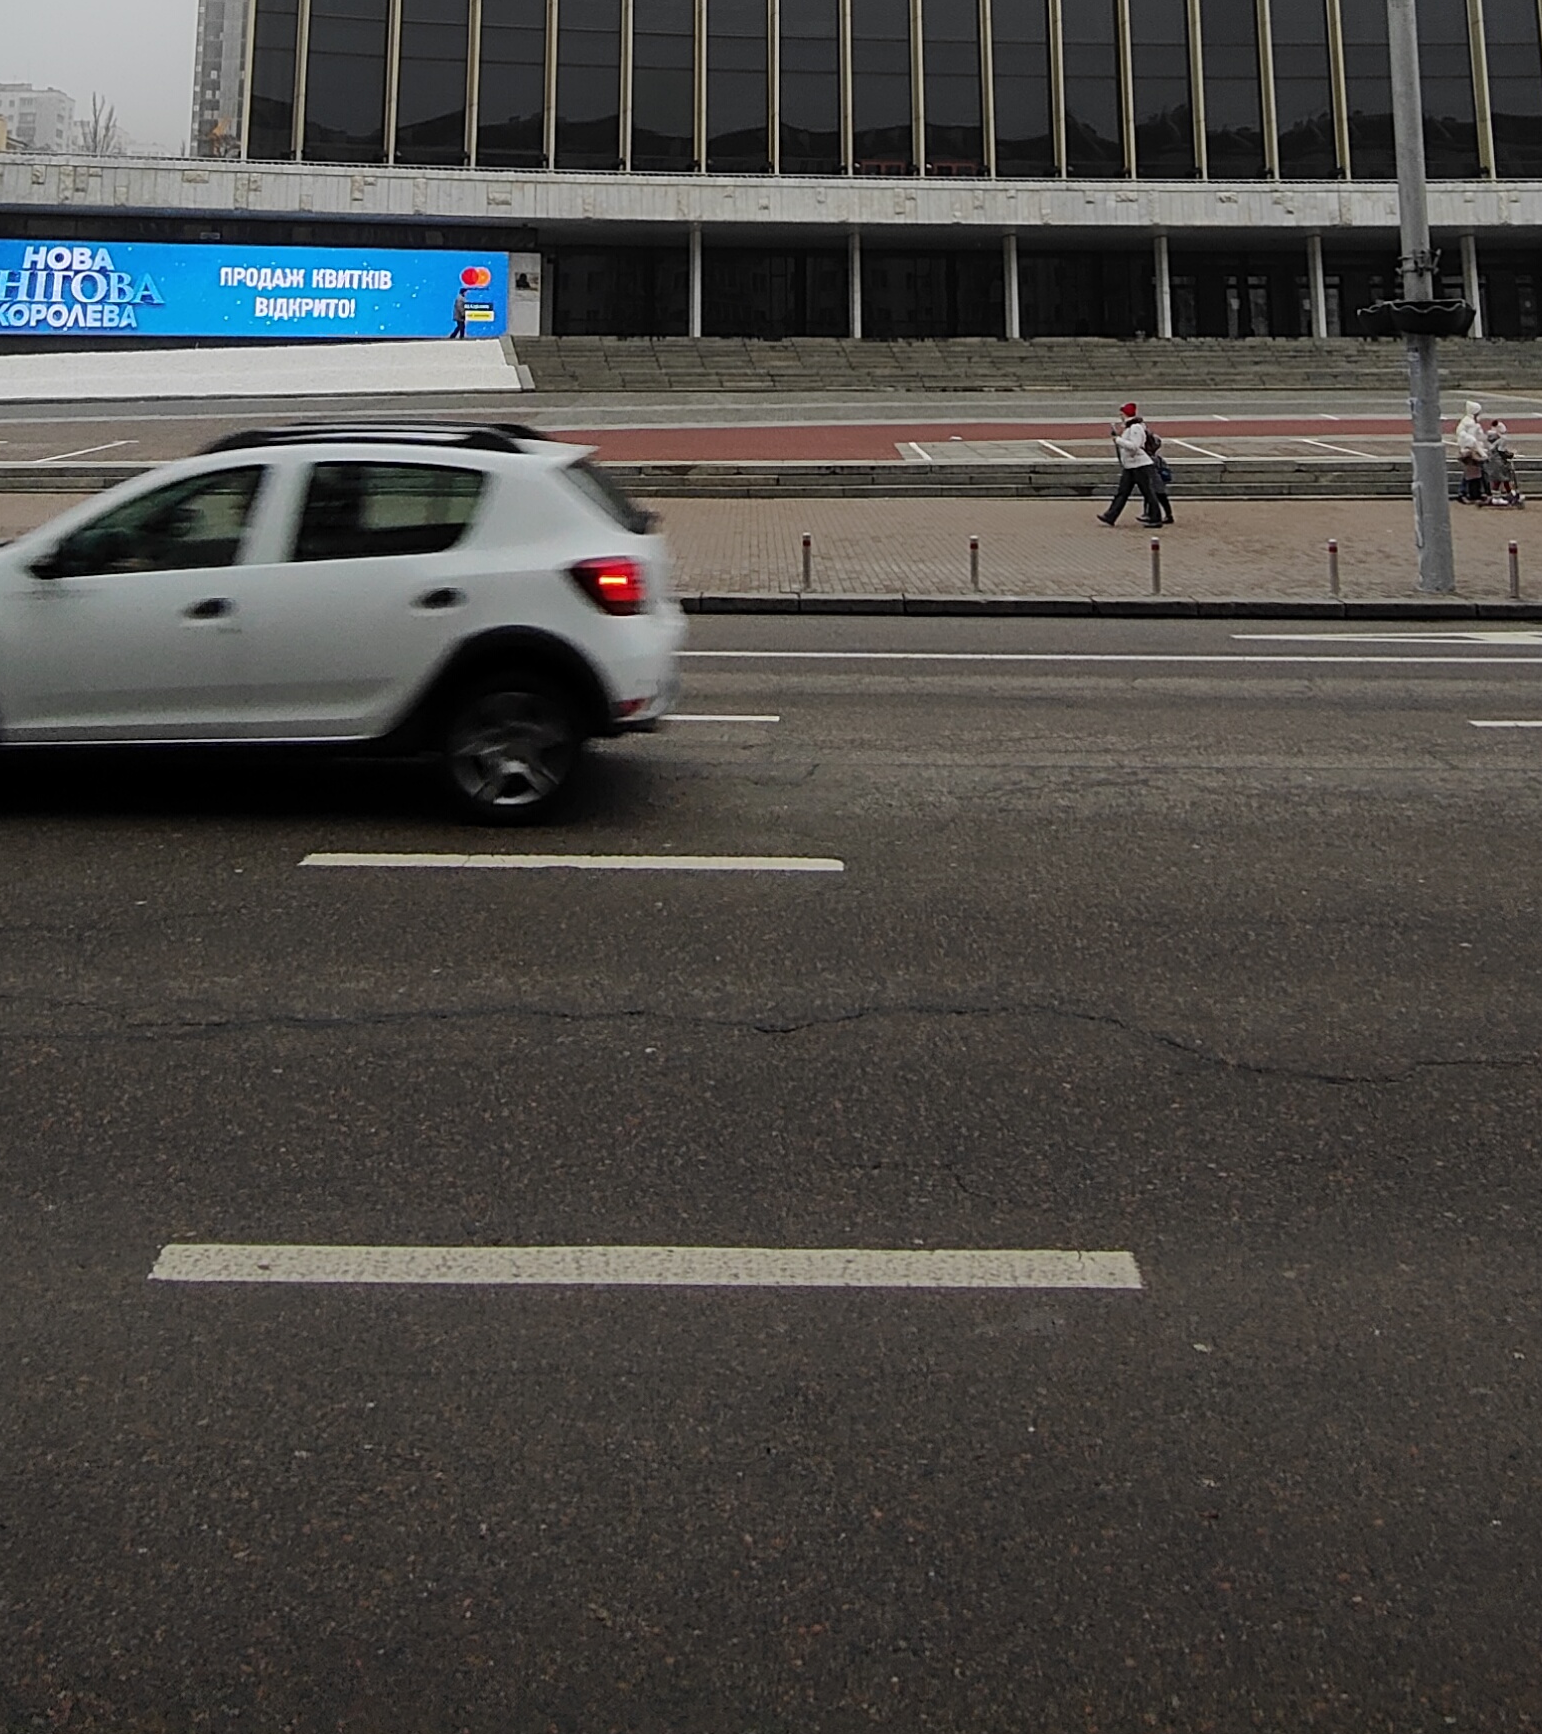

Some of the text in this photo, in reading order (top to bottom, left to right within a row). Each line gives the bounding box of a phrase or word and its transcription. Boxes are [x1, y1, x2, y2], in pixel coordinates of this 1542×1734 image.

[22, 246, 115, 270] НОВА
[220, 266, 393, 290] ПРОДАЖ КВИТКІВ
[255, 296, 356, 319] ВІДКРИТО!
